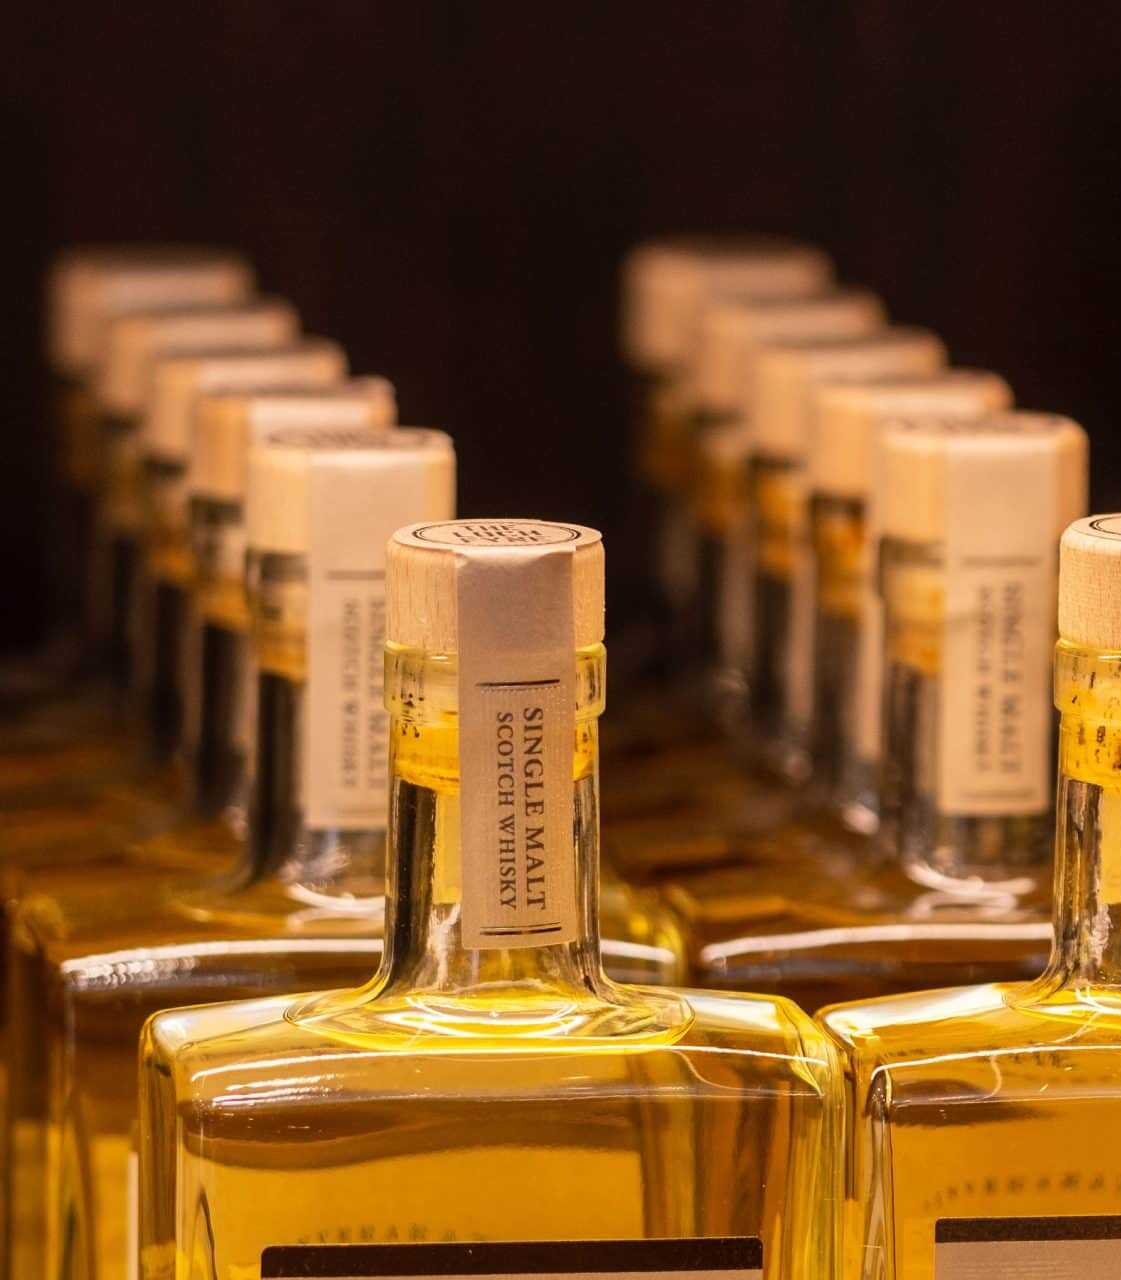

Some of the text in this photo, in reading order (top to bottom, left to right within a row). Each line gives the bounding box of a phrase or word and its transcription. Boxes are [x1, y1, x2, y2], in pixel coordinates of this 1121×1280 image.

[496, 711, 517, 910] SCOTCH WHISKY
[522, 707, 546, 911] SINGLE MALT
